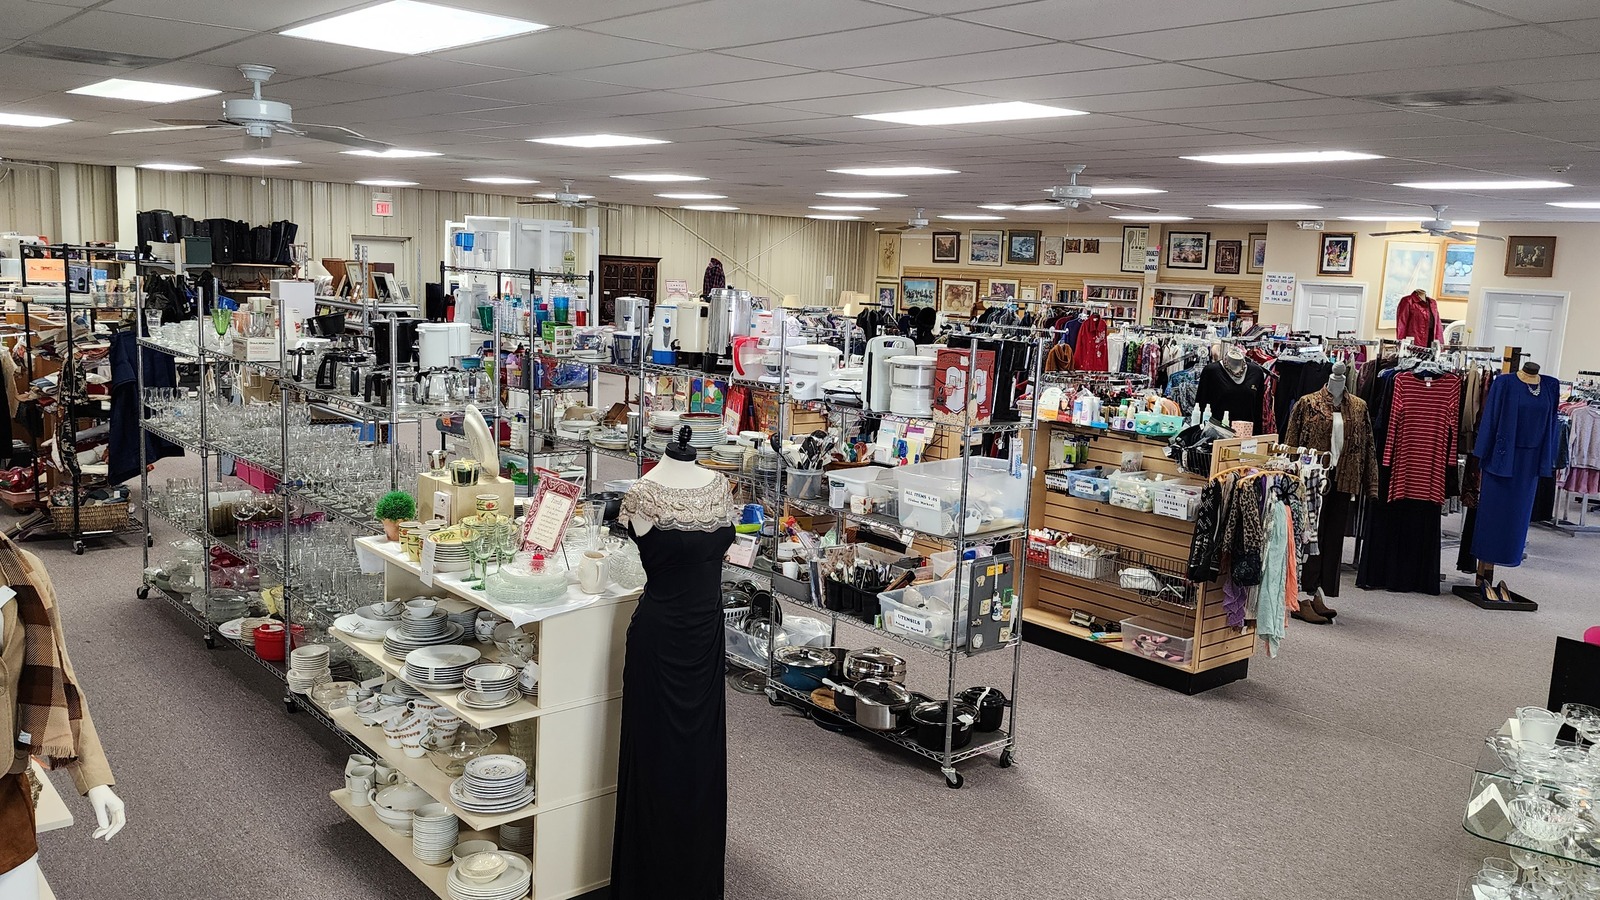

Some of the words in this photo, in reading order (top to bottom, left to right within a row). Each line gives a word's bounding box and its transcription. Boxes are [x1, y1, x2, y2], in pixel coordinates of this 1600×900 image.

[376, 203, 389, 214] EXIT
[1156, 498, 1186, 508] ACCESSORIES
[897, 613, 921, 626] UTENSILS
